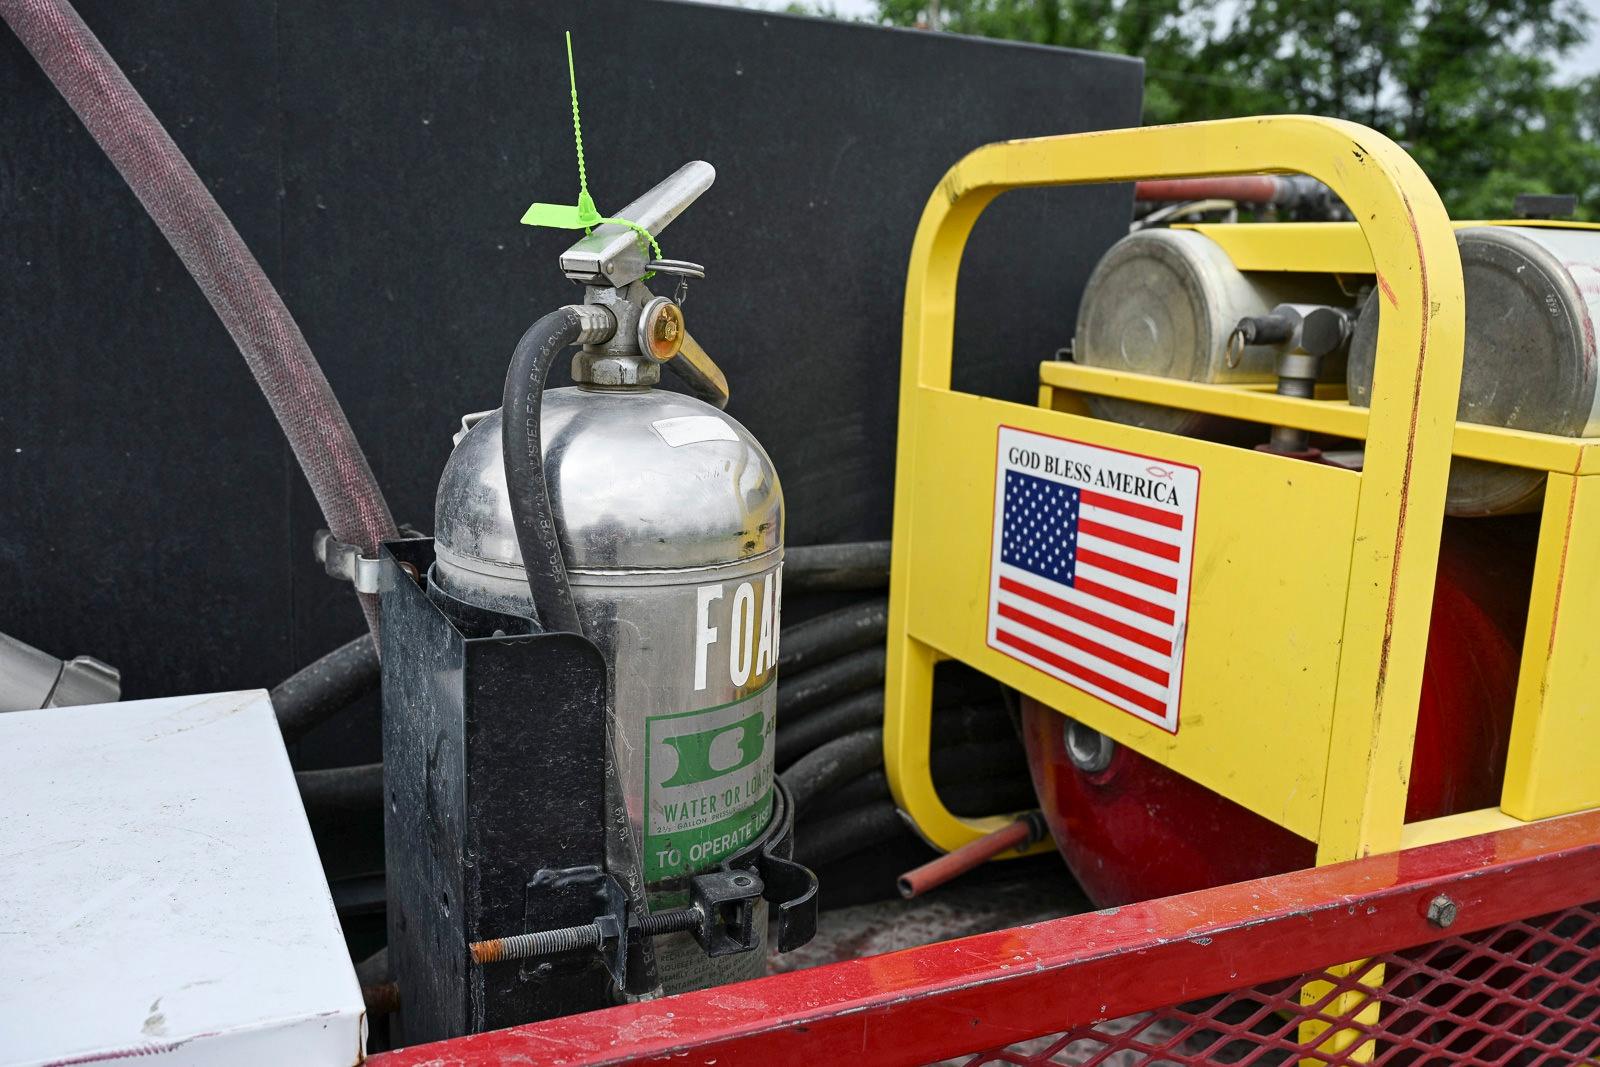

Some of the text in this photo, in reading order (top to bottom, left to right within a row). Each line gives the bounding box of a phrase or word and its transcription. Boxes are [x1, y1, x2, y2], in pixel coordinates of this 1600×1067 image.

[1008, 446, 1180, 507] GOD BLESS AMERICA
[663, 795, 717, 823] WATER
[725, 786, 741, 808] OR
[677, 817, 707, 830] GALLON
[655, 849, 681, 869] TO
[689, 821, 753, 862] OPERATE
[626, 864, 643, 902] HOSE
